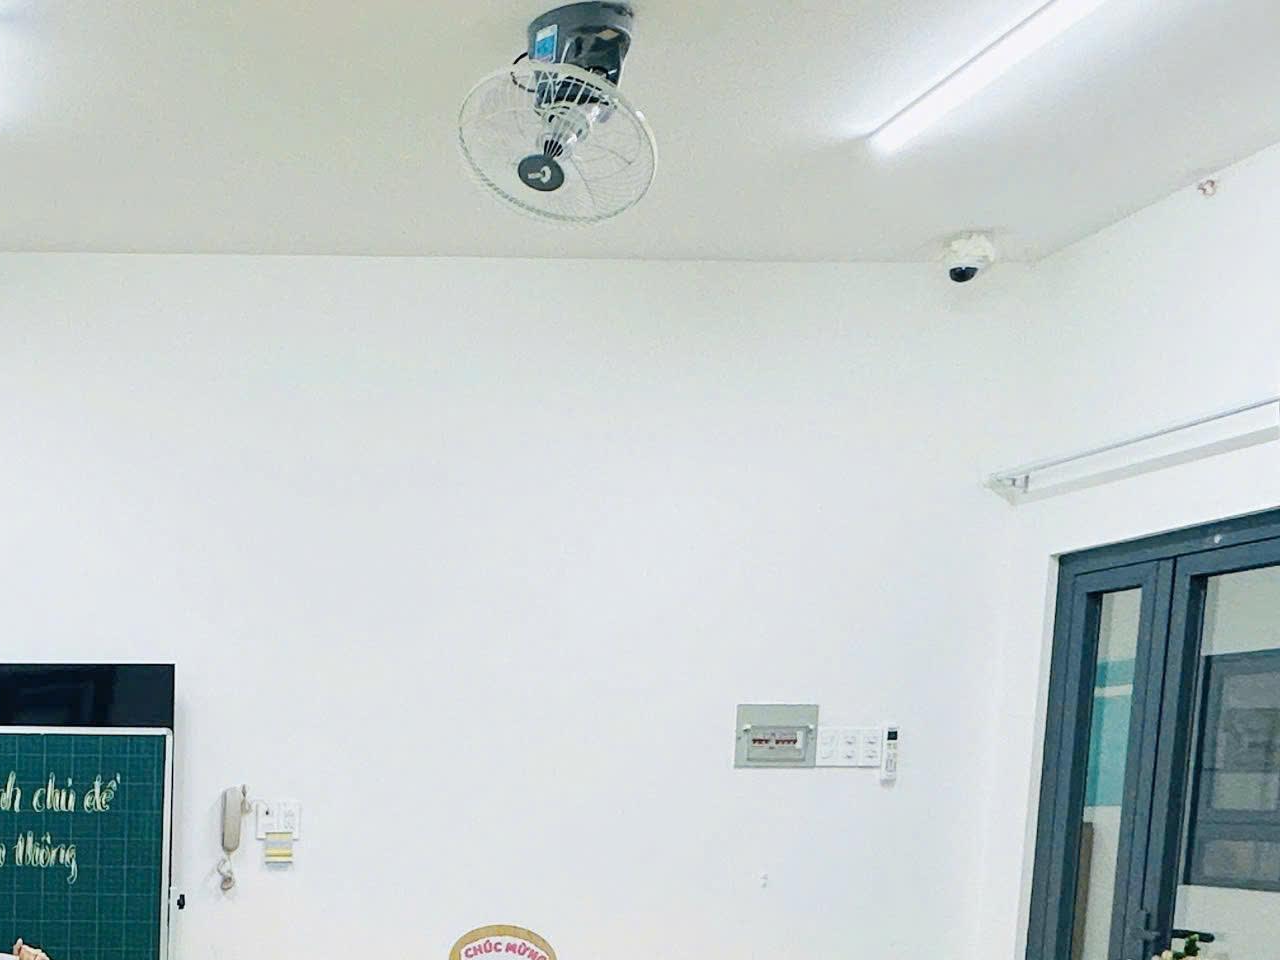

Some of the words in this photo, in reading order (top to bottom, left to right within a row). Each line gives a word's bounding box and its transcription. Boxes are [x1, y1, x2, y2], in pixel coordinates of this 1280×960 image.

[84, 772, 121, 814] đề
[13, 830, 78, 885] thông
[464, 940, 502, 958] CHÚC
